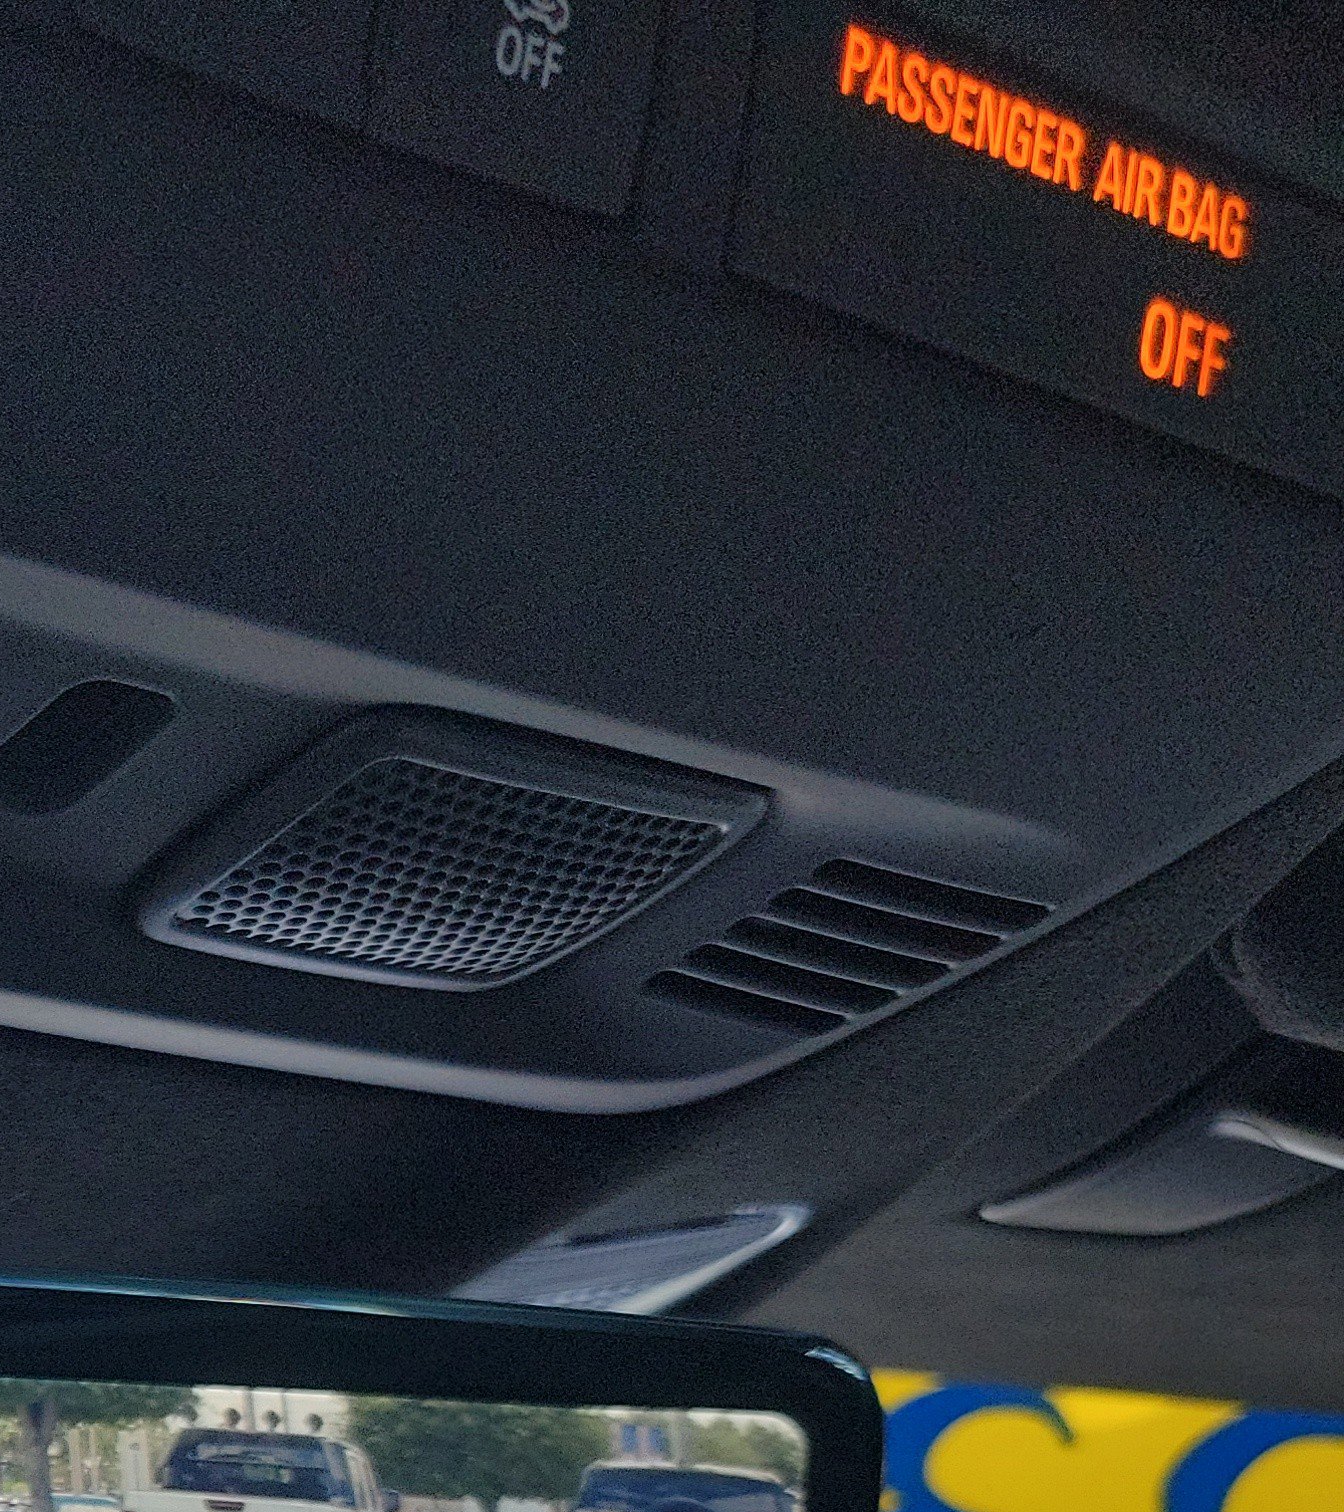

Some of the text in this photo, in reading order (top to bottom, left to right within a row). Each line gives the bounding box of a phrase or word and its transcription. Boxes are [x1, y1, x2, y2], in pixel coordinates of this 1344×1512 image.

[495, 26, 565, 89] OFF
[839, 24, 1250, 261] PASSENGER AIR BAG
[1139, 296, 1232, 398] OFF
